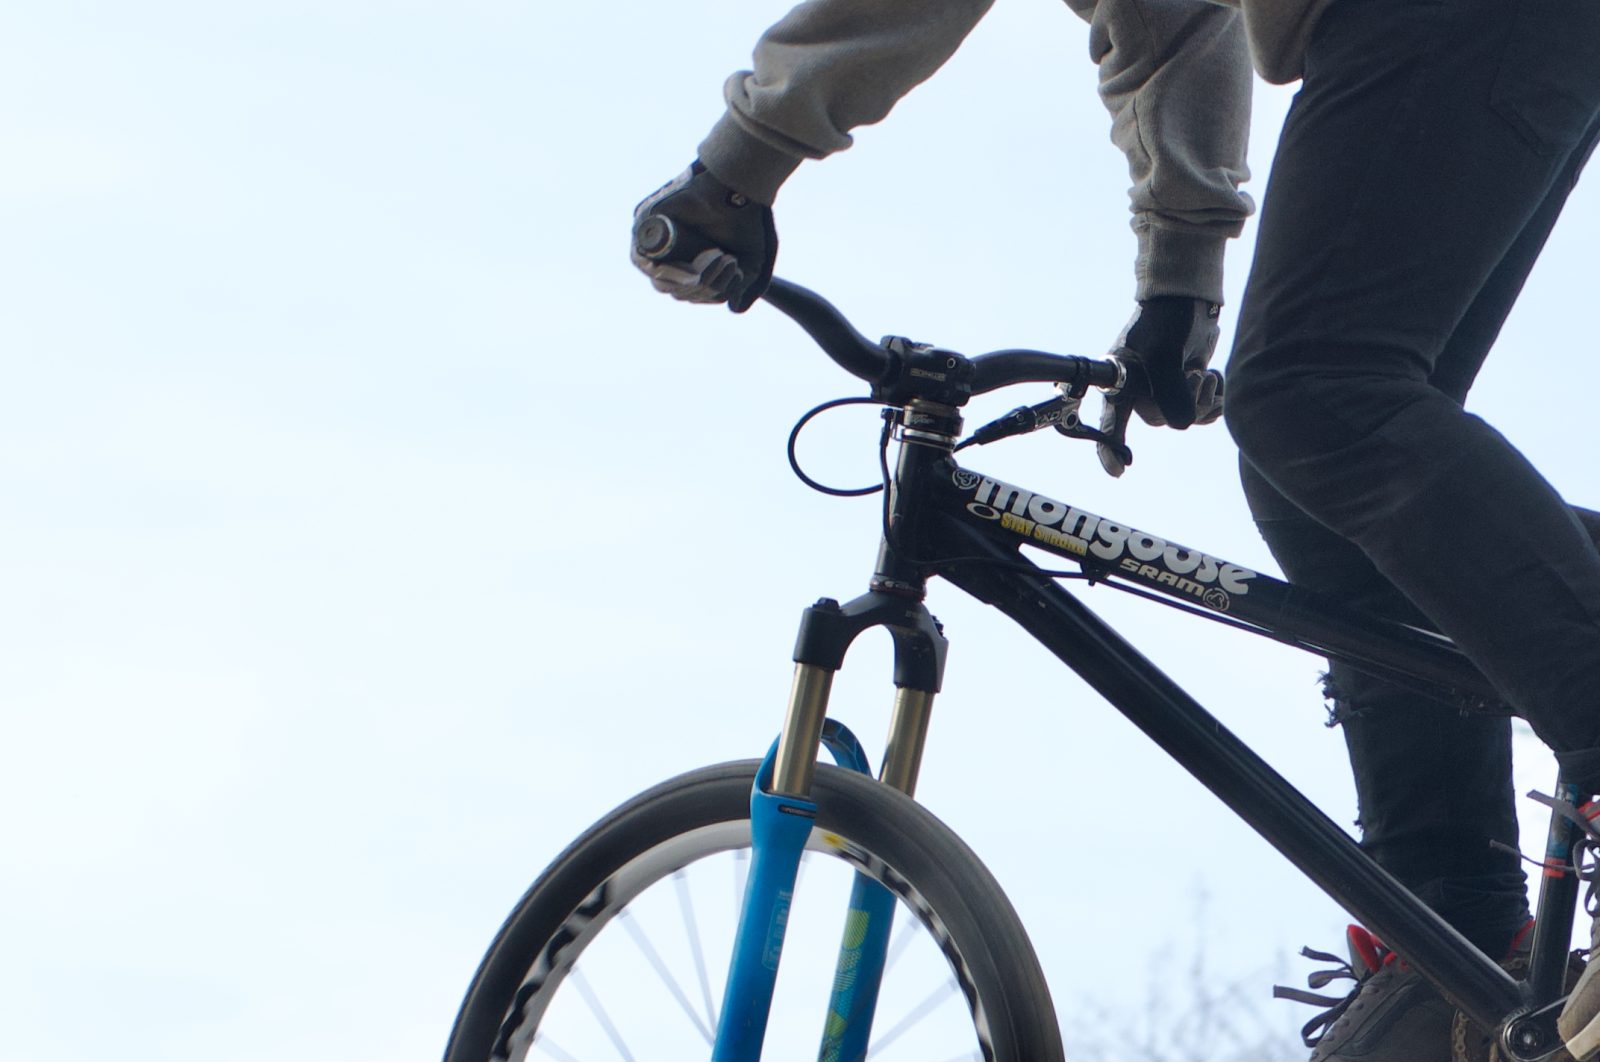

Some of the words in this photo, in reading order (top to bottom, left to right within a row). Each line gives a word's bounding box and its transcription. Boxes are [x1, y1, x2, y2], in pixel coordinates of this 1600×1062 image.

[974, 477, 1257, 595] mongoose
[1000, 511, 1036, 537] STAY
[1119, 558, 1205, 597] SRAM
